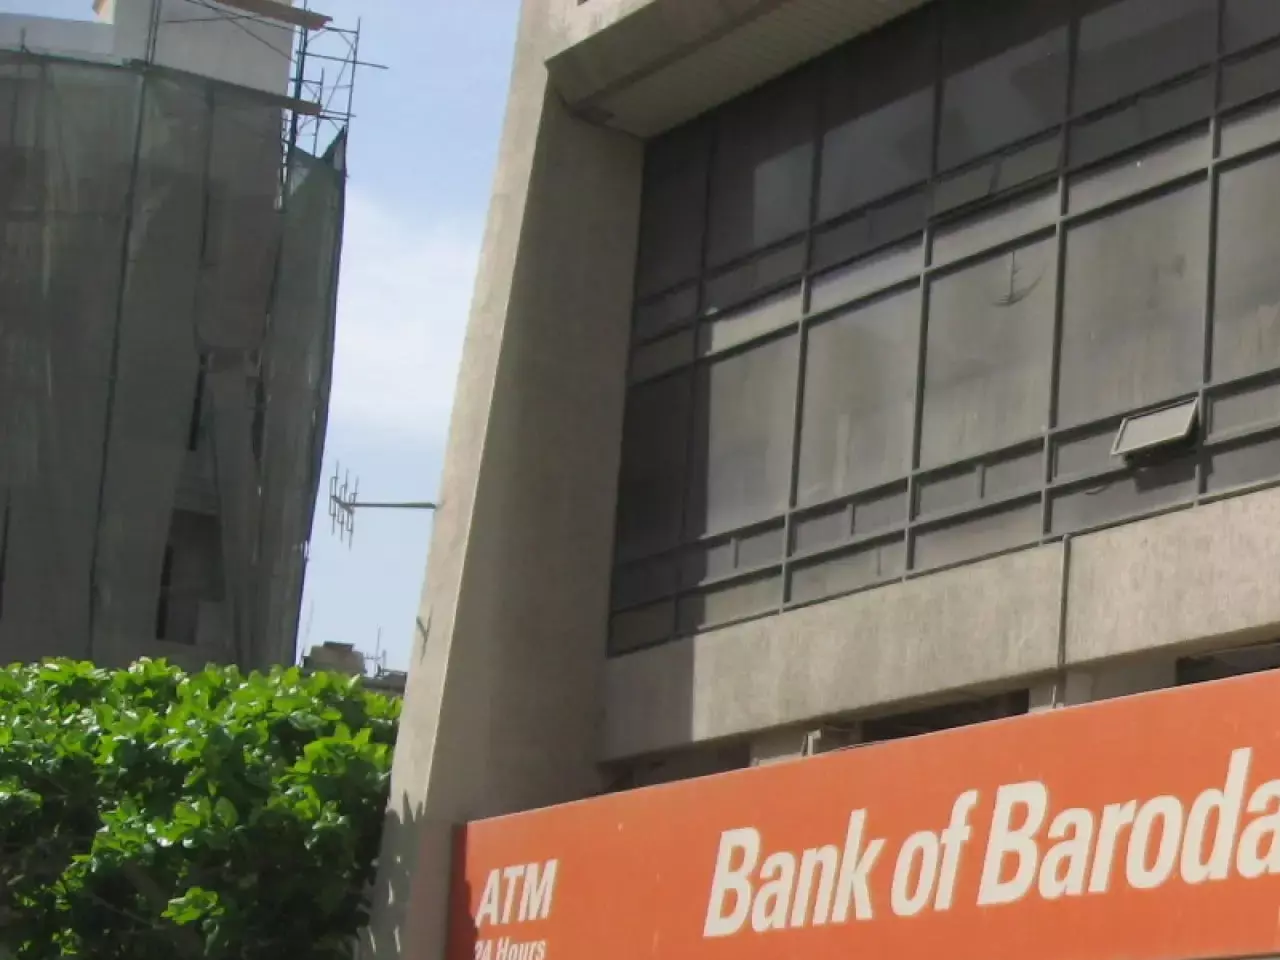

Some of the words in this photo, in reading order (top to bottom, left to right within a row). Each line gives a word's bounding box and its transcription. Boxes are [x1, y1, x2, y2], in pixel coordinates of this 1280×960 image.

[475, 858, 558, 928] ATM
[704, 809, 886, 938] Bank
[891, 789, 978, 917] of
